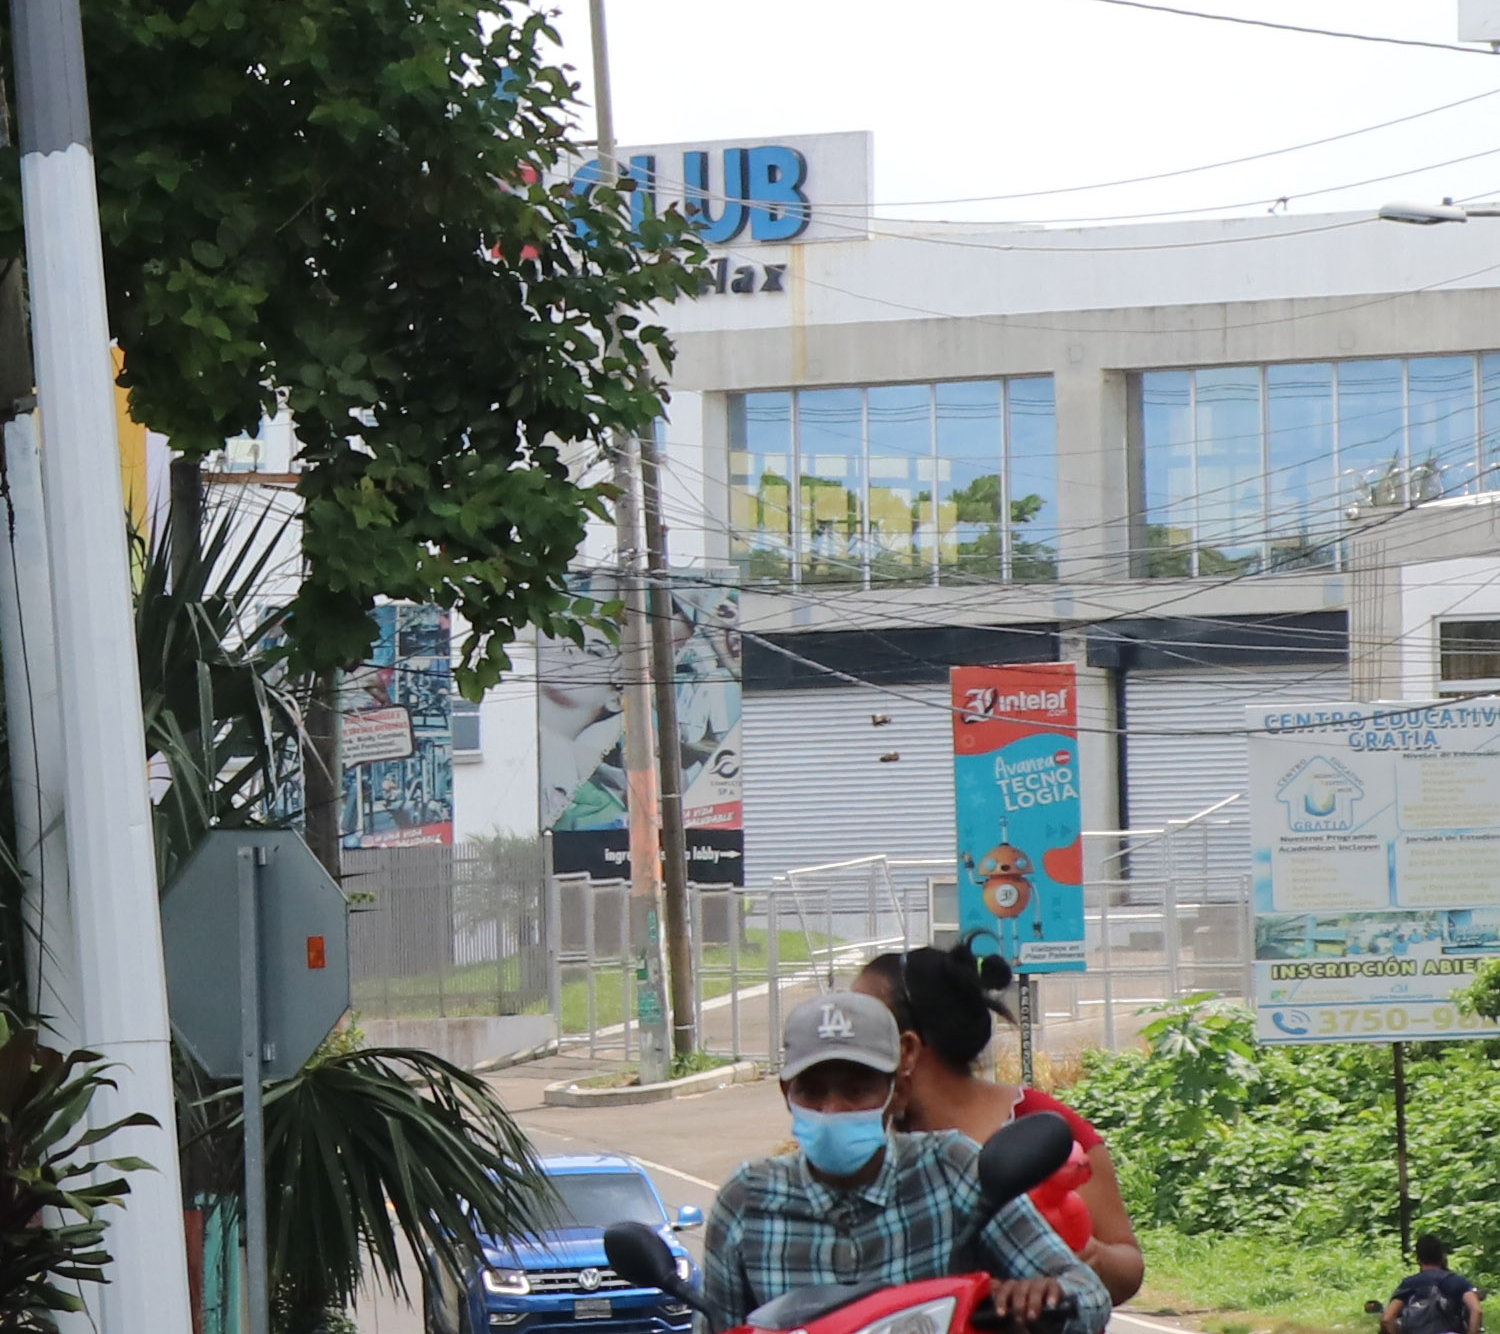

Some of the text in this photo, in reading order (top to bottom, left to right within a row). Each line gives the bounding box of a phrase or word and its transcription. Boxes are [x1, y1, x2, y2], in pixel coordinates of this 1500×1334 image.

[999, 689, 1068, 712] intelaf
[1265, 711, 1363, 735] CENTRO
[1349, 729, 1441, 751] GRATIA
[996, 767, 1073, 795] TECNO
[1294, 820, 1347, 831] GRATIA
[692, 845, 721, 864] lobby
[1271, 955, 1417, 981] INSCRIPCIÓN
[817, 1002, 856, 1039] LA
